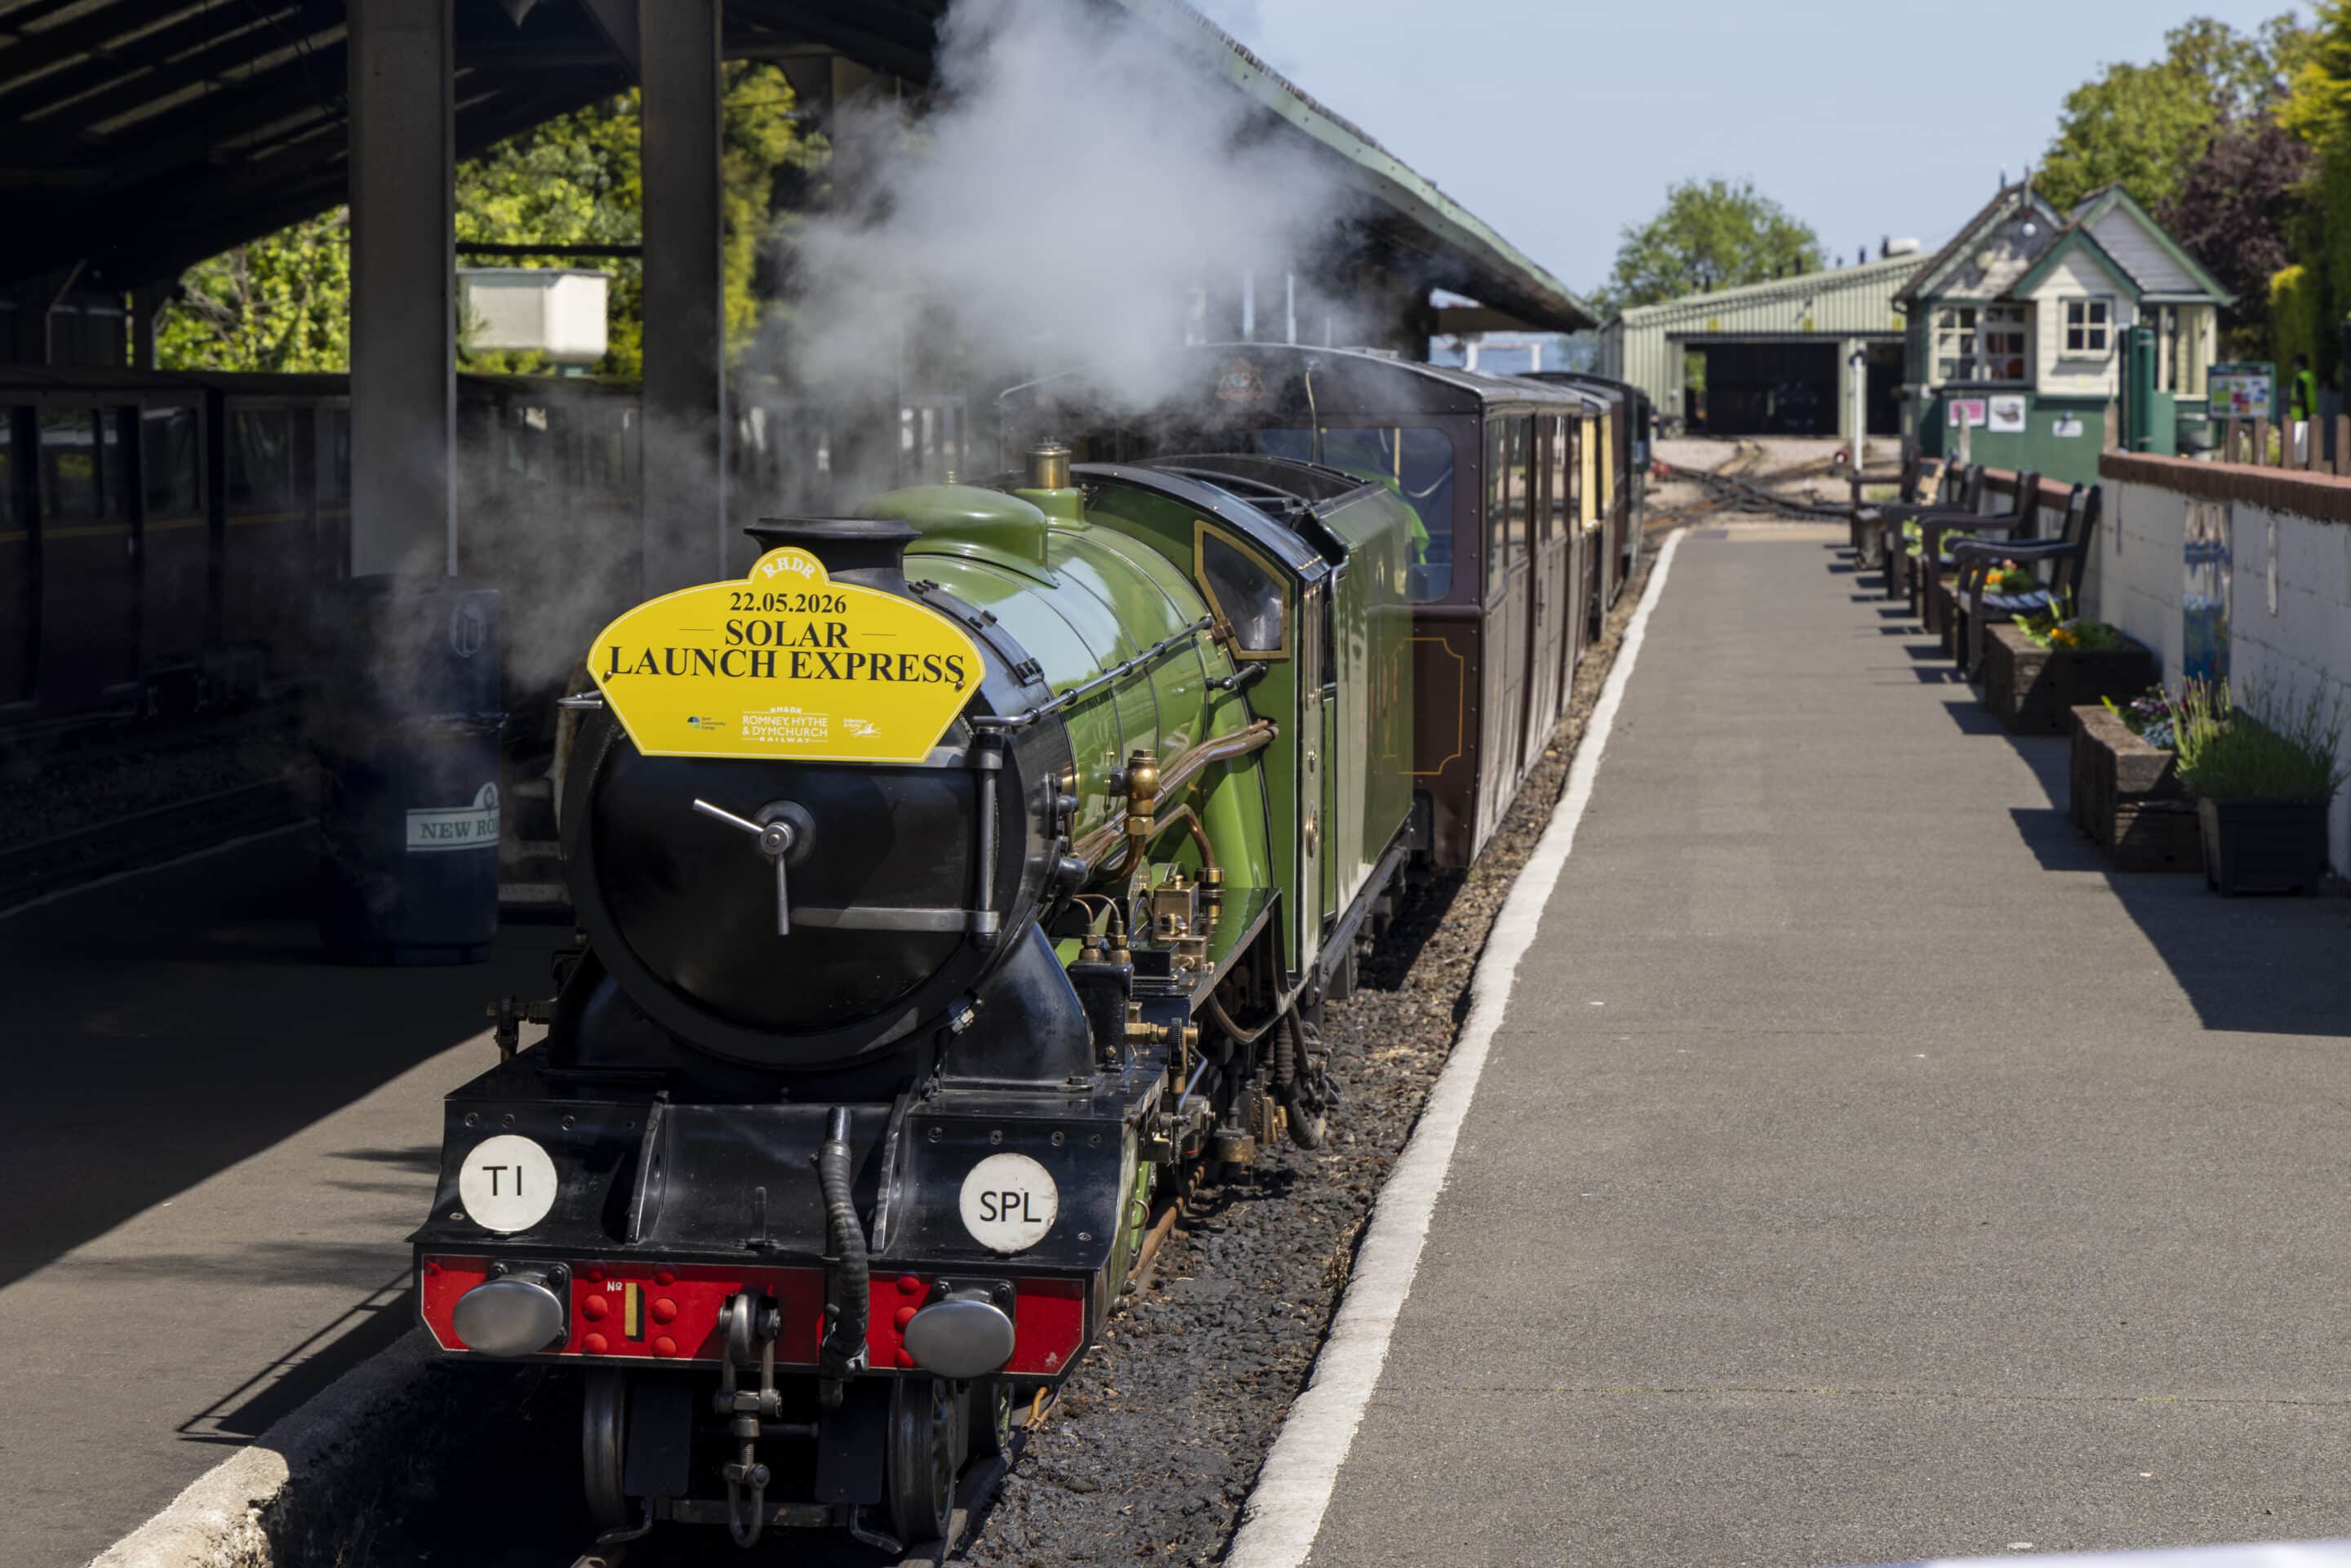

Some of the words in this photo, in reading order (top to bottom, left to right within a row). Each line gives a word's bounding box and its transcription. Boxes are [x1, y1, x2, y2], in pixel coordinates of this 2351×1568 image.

[762, 557, 816, 579] RHDR
[730, 592, 847, 614] 22.05.2026
[725, 619, 850, 648] SOLAR
[609, 646, 778, 678] LAUNCH
[789, 651, 965, 684] EXPRESS
[741, 726, 750, 735] &
[752, 726, 829, 737] DYMCHURCH
[791, 717, 829, 727] HYTHE
[419, 822, 471, 839] NEW
[980, 1191, 1042, 1223] SPL
